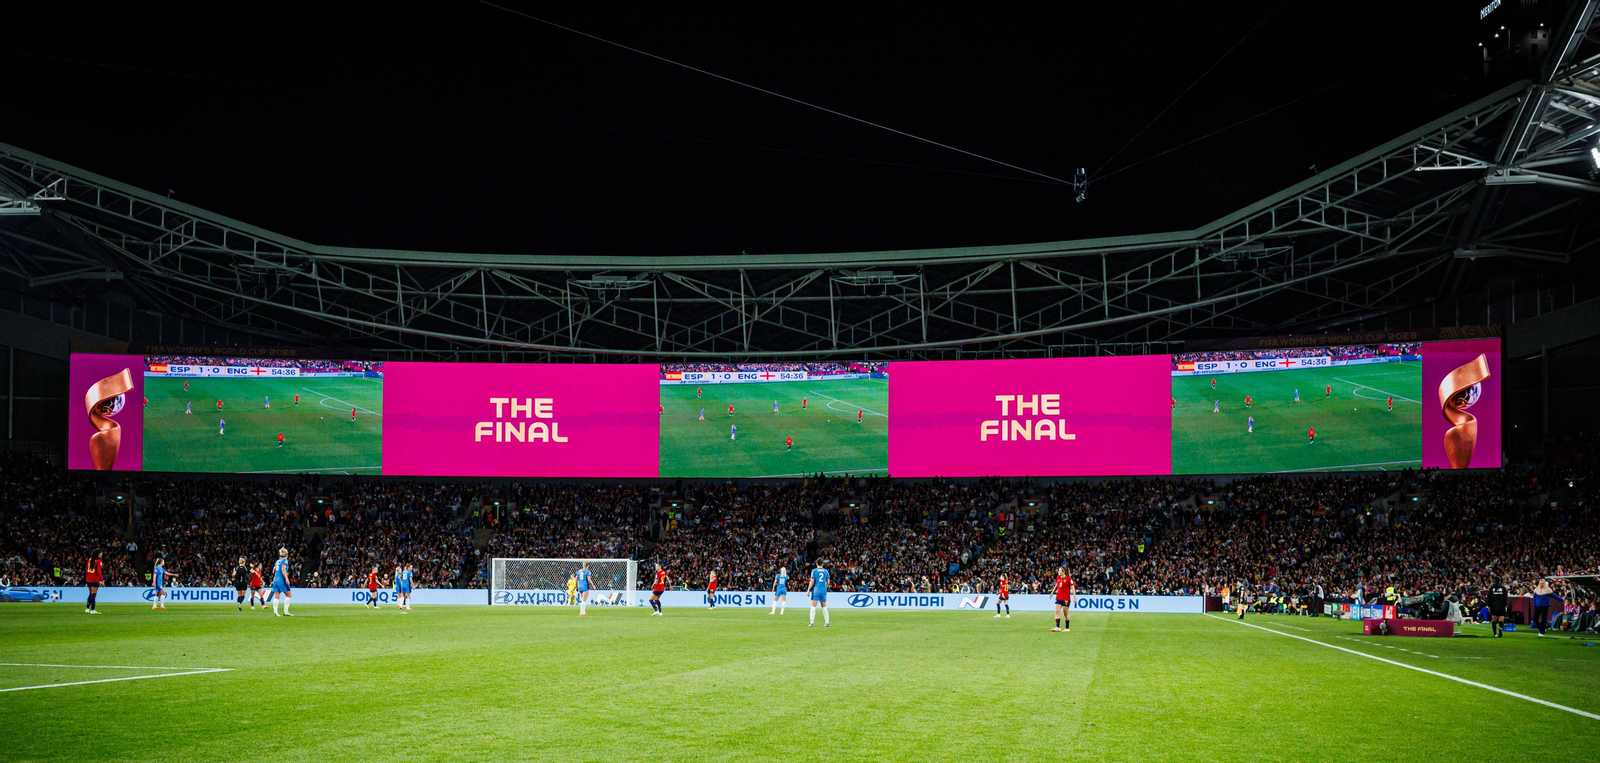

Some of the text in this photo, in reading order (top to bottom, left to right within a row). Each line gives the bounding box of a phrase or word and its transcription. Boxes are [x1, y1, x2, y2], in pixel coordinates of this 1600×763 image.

[1480, 0, 1501, 20] MERITON
[1259, 332, 1417, 347] FIFA WOMEN'S WORLD CUP 2023
[146, 345, 296, 357] FIFA WOMEN'S WORLD CUP 2023
[1301, 358, 1327, 366] 54:36
[490, 397, 553, 418] THE
[995, 394, 1060, 416] THE
[475, 421, 568, 442] FINAL
[980, 419, 1076, 441] FINAL
[819, 572, 824, 582] 2
[171, 590, 234, 600] HYUNDAI
[703, 594, 766, 607] IONIQ 5 N
[878, 596, 944, 607] HYUNDAI
[1117, 598, 1126, 609] 5
[1129, 598, 1139, 609] N
